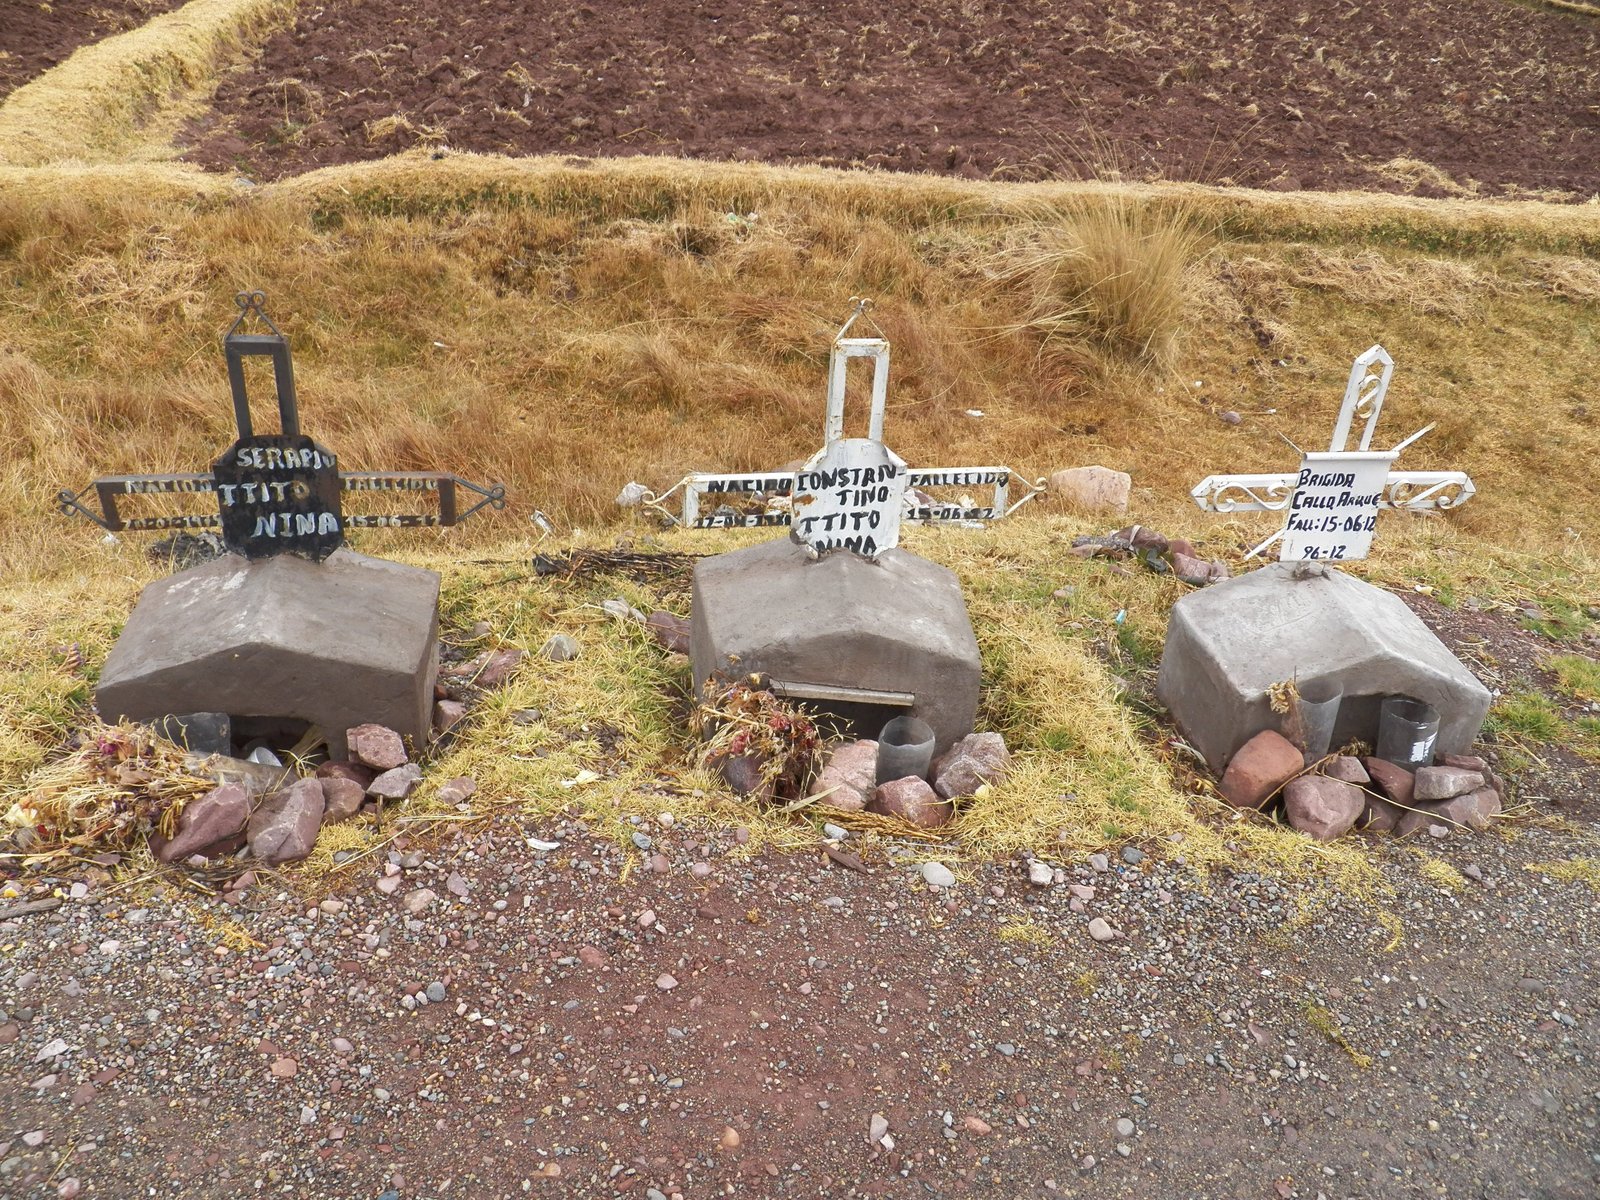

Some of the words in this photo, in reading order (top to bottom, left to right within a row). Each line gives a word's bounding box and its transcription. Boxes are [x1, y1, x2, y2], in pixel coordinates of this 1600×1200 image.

[218, 481, 310, 507] TTITO
[835, 486, 889, 507] TINO
[251, 512, 339, 538] NINA
[800, 510, 881, 534] TTITO
[816, 535, 878, 554] NINA
[1302, 545, 1347, 560] 96-12
